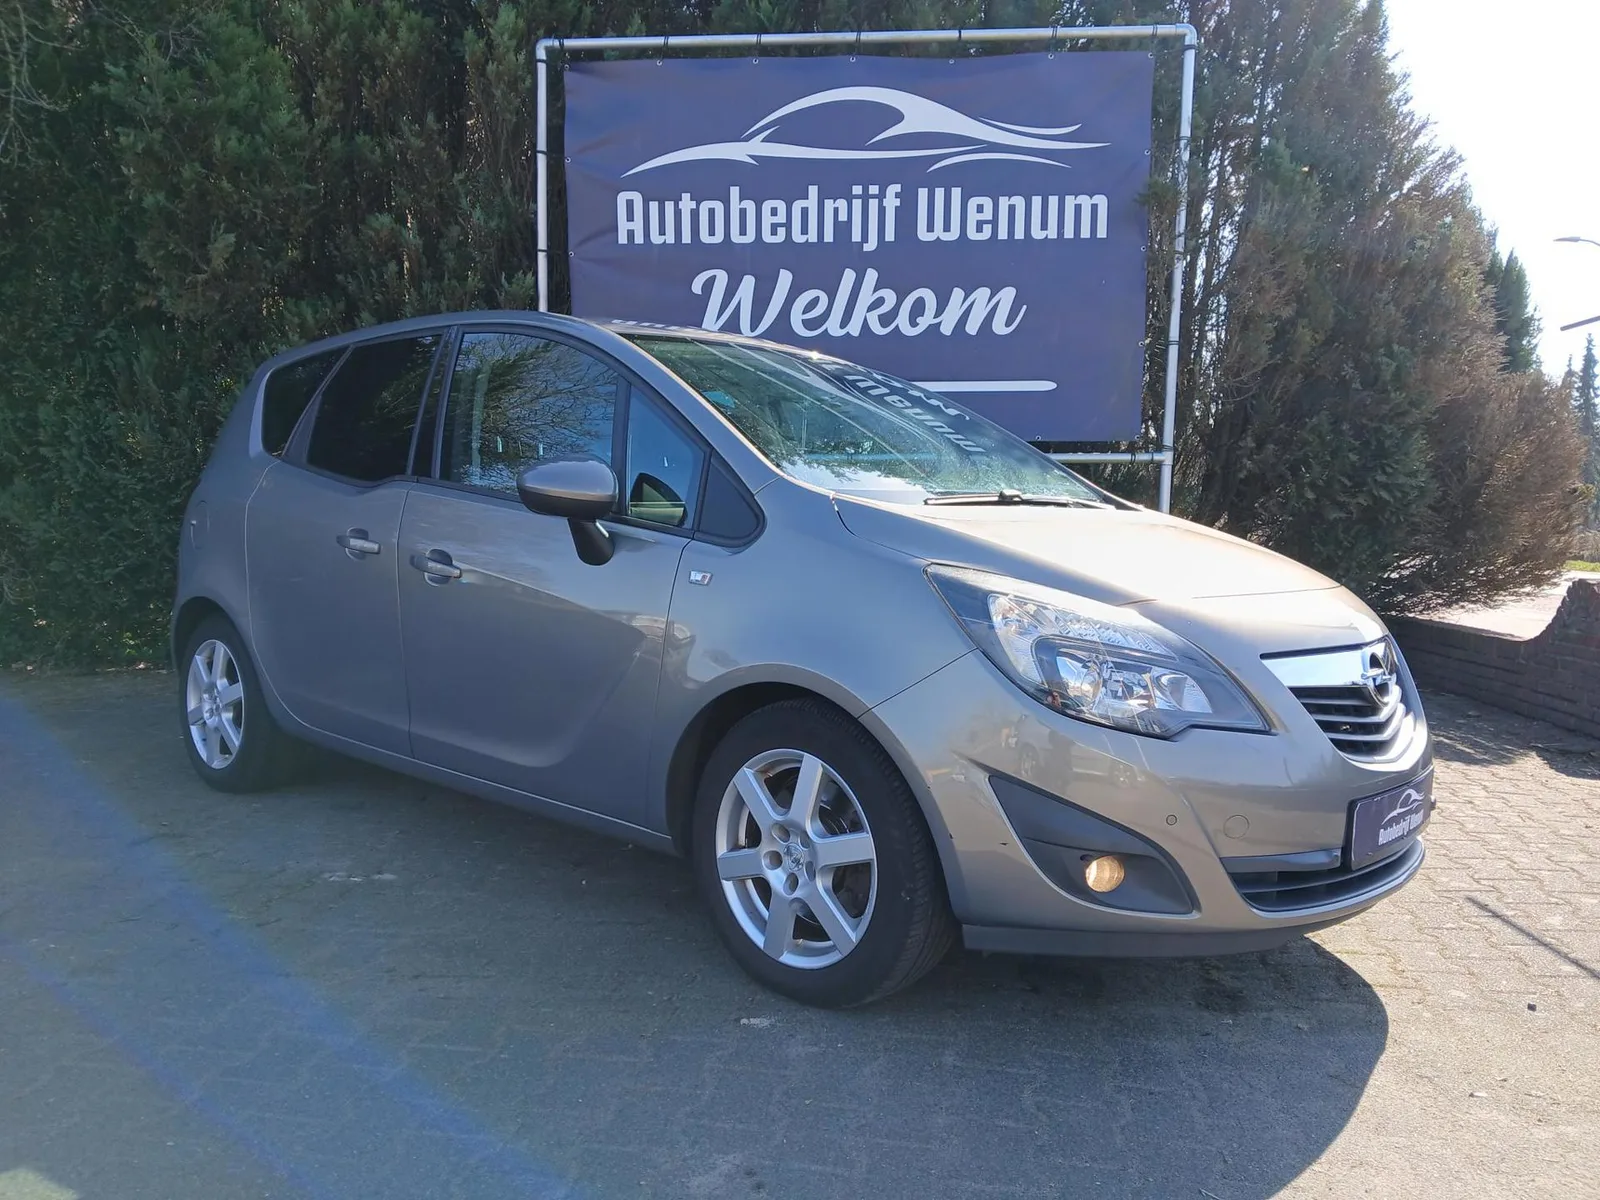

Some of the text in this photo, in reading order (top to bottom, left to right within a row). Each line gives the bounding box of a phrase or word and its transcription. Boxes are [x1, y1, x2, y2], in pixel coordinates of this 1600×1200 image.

[616, 184, 1108, 252] Autobedrijf Wenum
[691, 267, 1027, 338] Welkom
